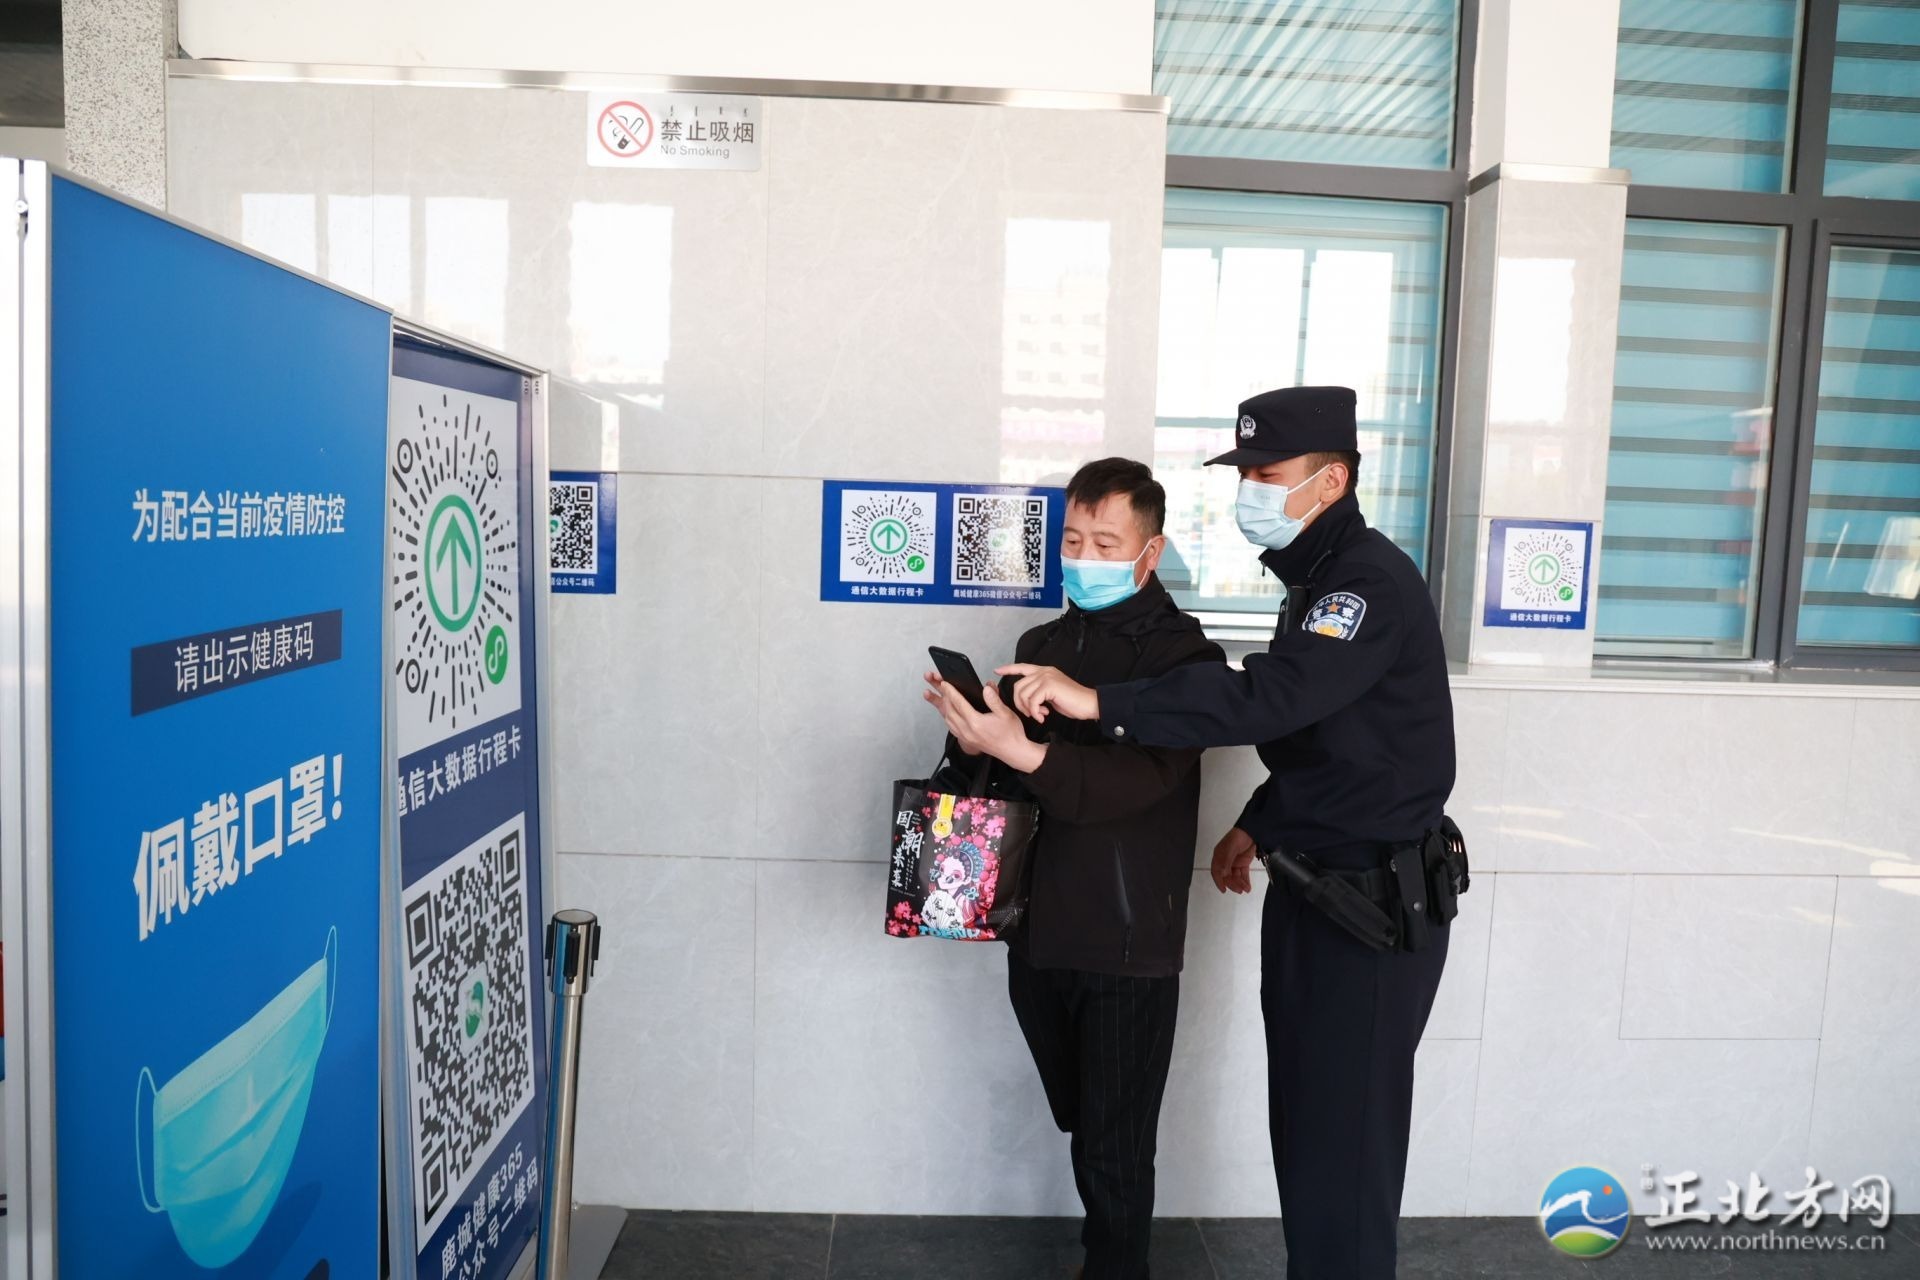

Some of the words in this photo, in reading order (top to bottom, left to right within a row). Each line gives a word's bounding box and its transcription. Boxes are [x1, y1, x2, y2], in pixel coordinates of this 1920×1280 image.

[661, 119, 755, 144] 禁止吸烟
[661, 145, 676, 155] No
[680, 146, 730, 159] Smoking
[131, 488, 346, 543] 为配合当前疫情防控
[851, 585, 925, 597] 通信大数据行程卡
[1509, 612, 1572, 623] 通信大数据行程卡
[174, 620, 315, 695] 请出示健康码
[133, 753, 344, 942] 佩戴口罩！
[442, 1142, 524, 1280] 鹿城健康365
